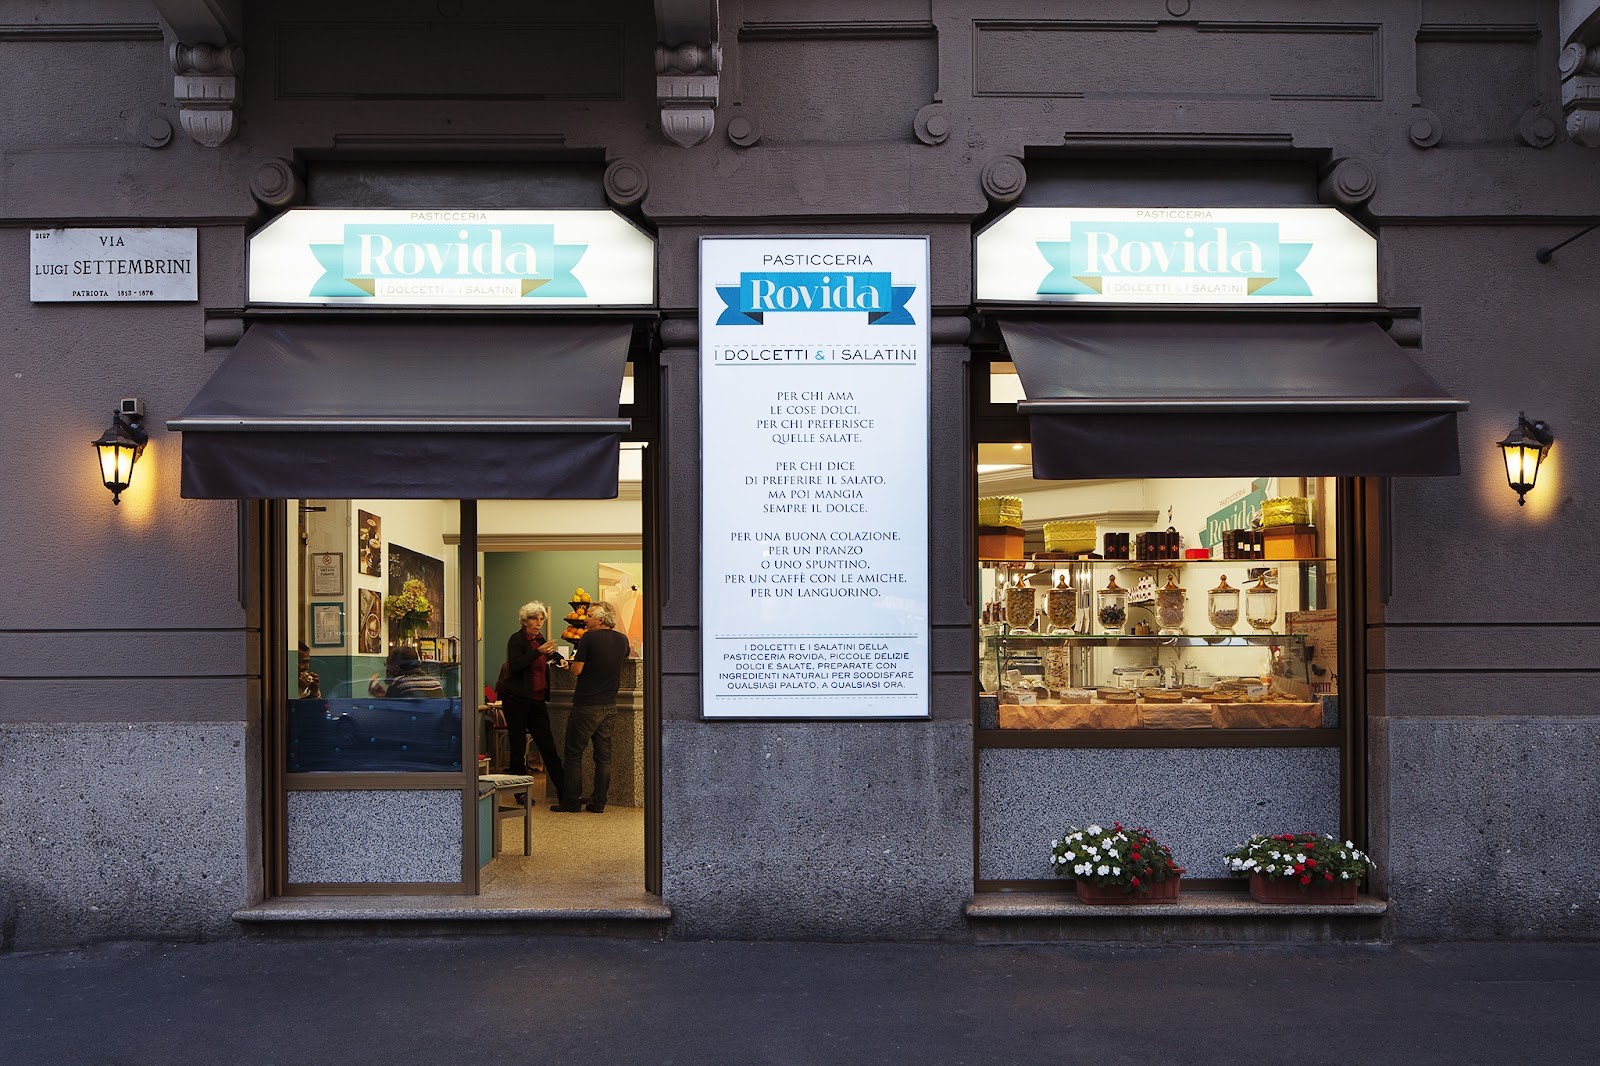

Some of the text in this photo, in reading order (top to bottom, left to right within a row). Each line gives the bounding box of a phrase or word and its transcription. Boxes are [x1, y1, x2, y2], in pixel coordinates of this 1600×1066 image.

[411, 212, 487, 221] PASTICCERIA
[1136, 210, 1213, 219] PASTICCERIA
[99, 236, 125, 247] VIA
[357, 229, 541, 276] Rovida
[1083, 227, 1265, 274] Rovida
[763, 254, 874, 266] PASTICCERIA
[35, 259, 191, 276] LUIGI SETTEMBRINI
[387, 286, 445, 295] DOLCETTI
[465, 286, 518, 295] SALATINI
[750, 275, 882, 311] Rovida
[1114, 284, 1171, 293] DOLCETTI
[1192, 284, 1244, 293] SALATINI
[724, 348, 808, 361] DOLCETTI
[814, 348, 826, 361] &
[841, 348, 917, 361] SALATINI
[777, 391, 855, 401] PER CHI AMA
[770, 405, 861, 415] LE COSE DOLCI.
[756, 419, 875, 429] PER CHI PREFERISCE
[771, 433, 816, 444] QUELLE
[776, 461, 855, 471] PER CHI DICE
[745, 475, 758, 485] DI
[763, 475, 823, 485] PREFERIRE
[826, 475, 838, 485] IL
[767, 489, 864, 499] MA POI MANGIA
[762, 503, 808, 513] SEMPRE
[811, 503, 822, 513] IL
[730, 531, 753, 541] PER
[755, 531, 781, 541] UNA
[785, 531, 827, 541] BUONA
[768, 546, 864, 556] PER UN PRANZO
[774, 560, 803, 570] UNO
[724, 573, 746, 584] PER
[749, 573, 767, 584] UN
[770, 571, 806, 584] CAFFÈ
[809, 573, 837, 584] CON
[841, 573, 854, 584] LE
[750, 587, 772, 598] PER
[775, 587, 793, 598] UN
[750, 643, 797, 652] DOLCETTI
[813, 643, 856, 652] SALATINI
[858, 643, 889, 652] DELLA
[723, 652, 786, 662] PASTICCERIA
[829, 652, 872, 662] PICCOLE
[874, 652, 910, 662] DELIZIE
[735, 662, 765, 671] DOLCI
[817, 662, 873, 671] PREPARATE
[875, 662, 897, 671] CON
[718, 671, 914, 681] INGREDIENTI NATURALI PER SODDISFARE
[726, 680, 777, 690] QUALSIASI
[830, 680, 881, 690] QUALSIASI
